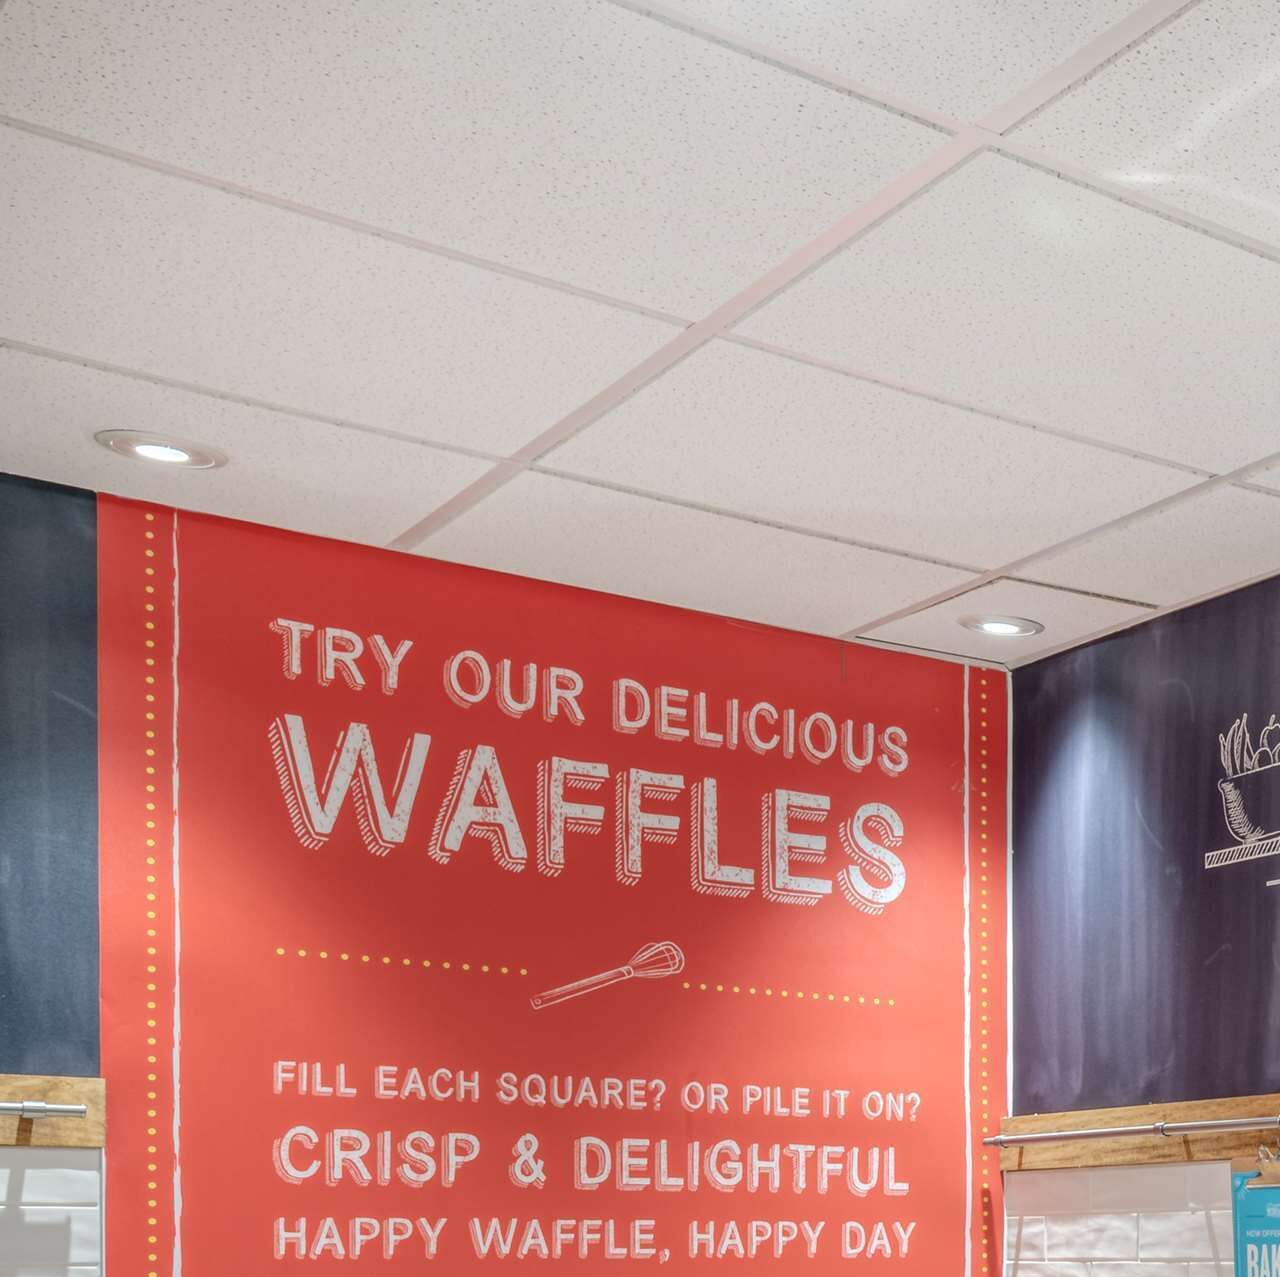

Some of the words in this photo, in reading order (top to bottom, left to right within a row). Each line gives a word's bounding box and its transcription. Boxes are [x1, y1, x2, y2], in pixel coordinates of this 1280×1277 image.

[269, 617, 413, 694] TRY
[443, 650, 585, 726] OUR
[612, 678, 909, 777] DELICIOUS
[268, 713, 906, 915] WAFFLES
[272, 1060, 357, 1098] FILL
[374, 1064, 480, 1102] EACH
[495, 1072, 665, 1112] SQUARE?
[681, 1081, 730, 1115] OR
[742, 1084, 811, 1119] PILE
[822, 1088, 850, 1120] IT
[862, 1089, 921, 1122] ON?
[273, 1124, 480, 1187] CRISP
[511, 1133, 547, 1189] &
[574, 1136, 910, 1197] DELIGHTFUL
[273, 1216, 447, 1260] HAPPY
[469, 1218, 671, 1264] WAFFLE,
[688, 1219, 826, 1259] HAPPY
[841, 1221, 917, 1258] DAY
